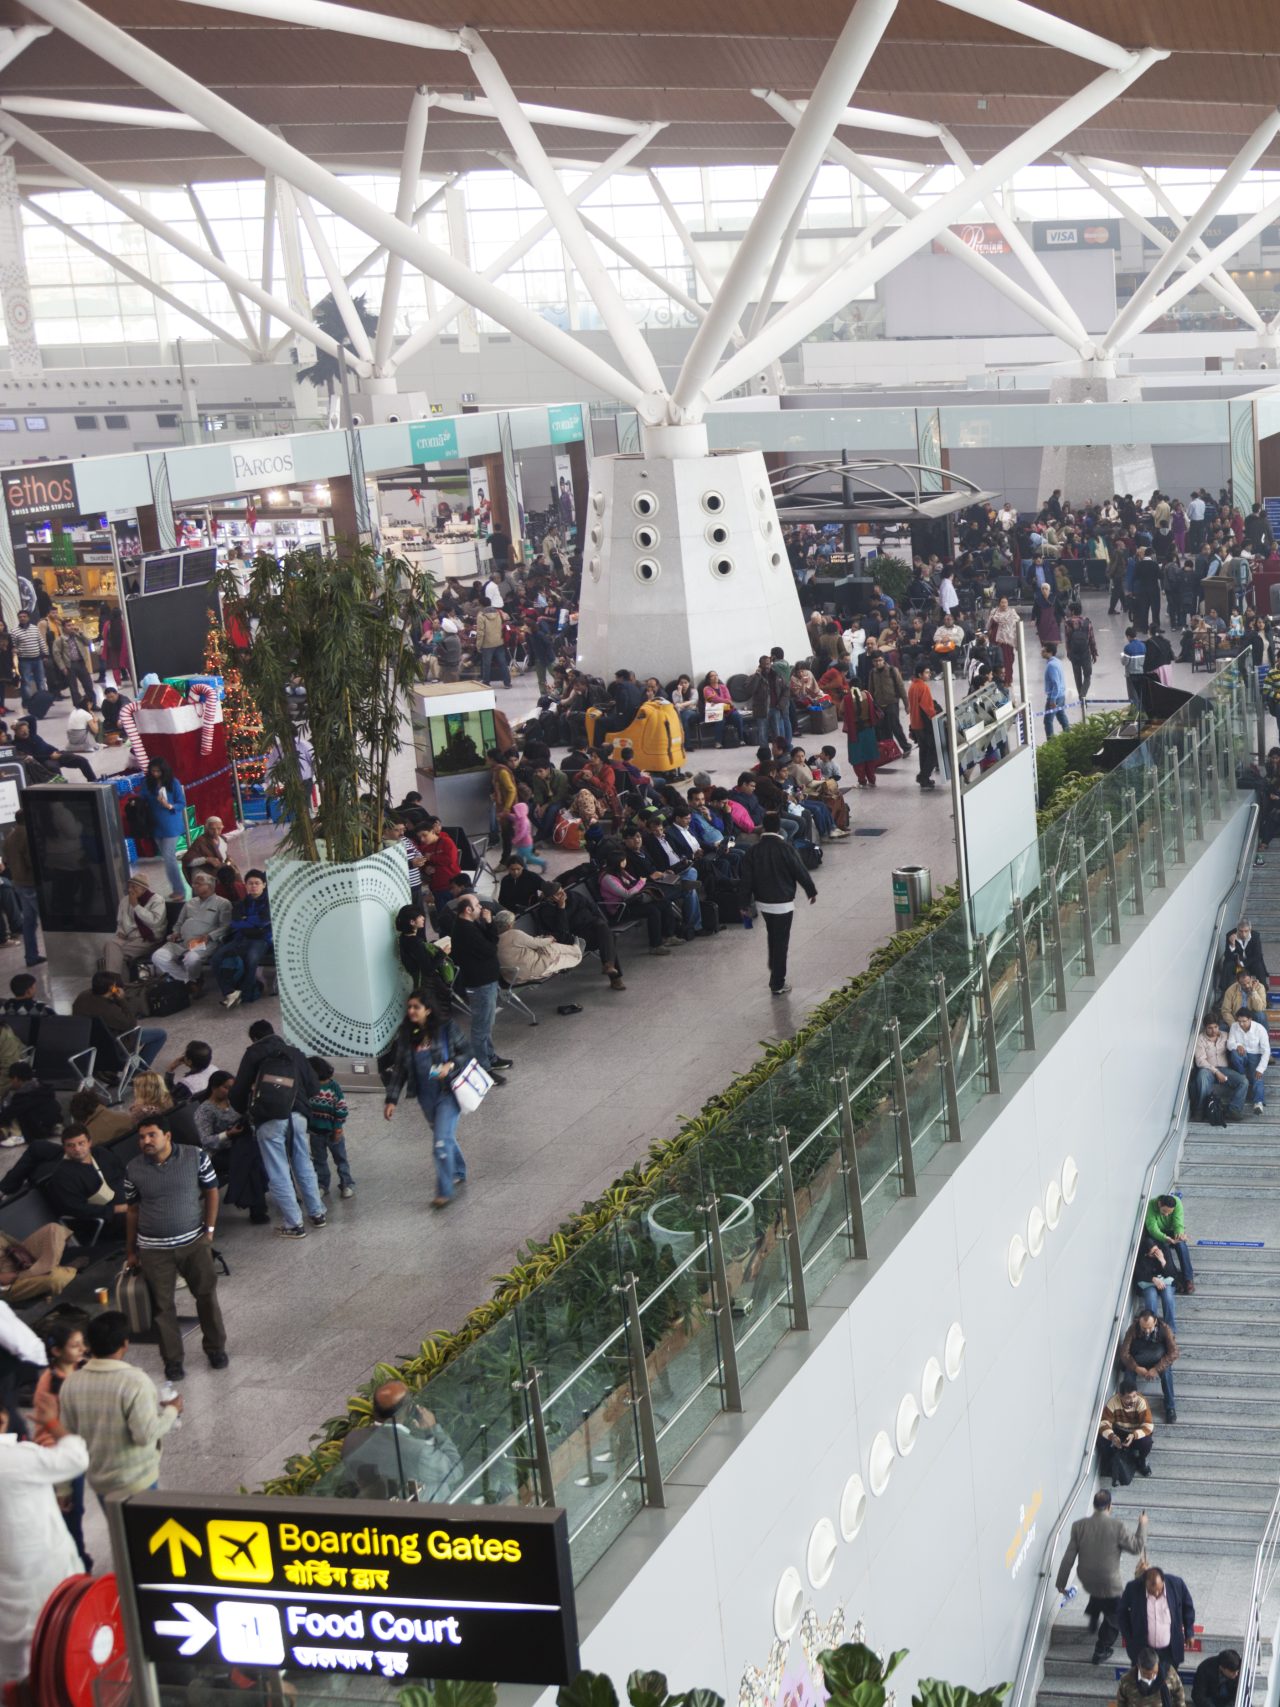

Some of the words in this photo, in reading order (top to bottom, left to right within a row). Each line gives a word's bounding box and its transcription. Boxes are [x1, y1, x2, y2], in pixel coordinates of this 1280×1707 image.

[1050, 231, 1076, 242] VISA
[233, 455, 293, 478] PARCOS
[11, 508, 29, 516] SWISS
[51, 502, 75, 511] STUDIOS
[278, 1522, 422, 1565] Boarding
[426, 1529, 522, 1563] Gates
[350, 1568, 390, 1591] द्वार
[286, 1605, 365, 1640] Food
[371, 1610, 461, 1644] Court
